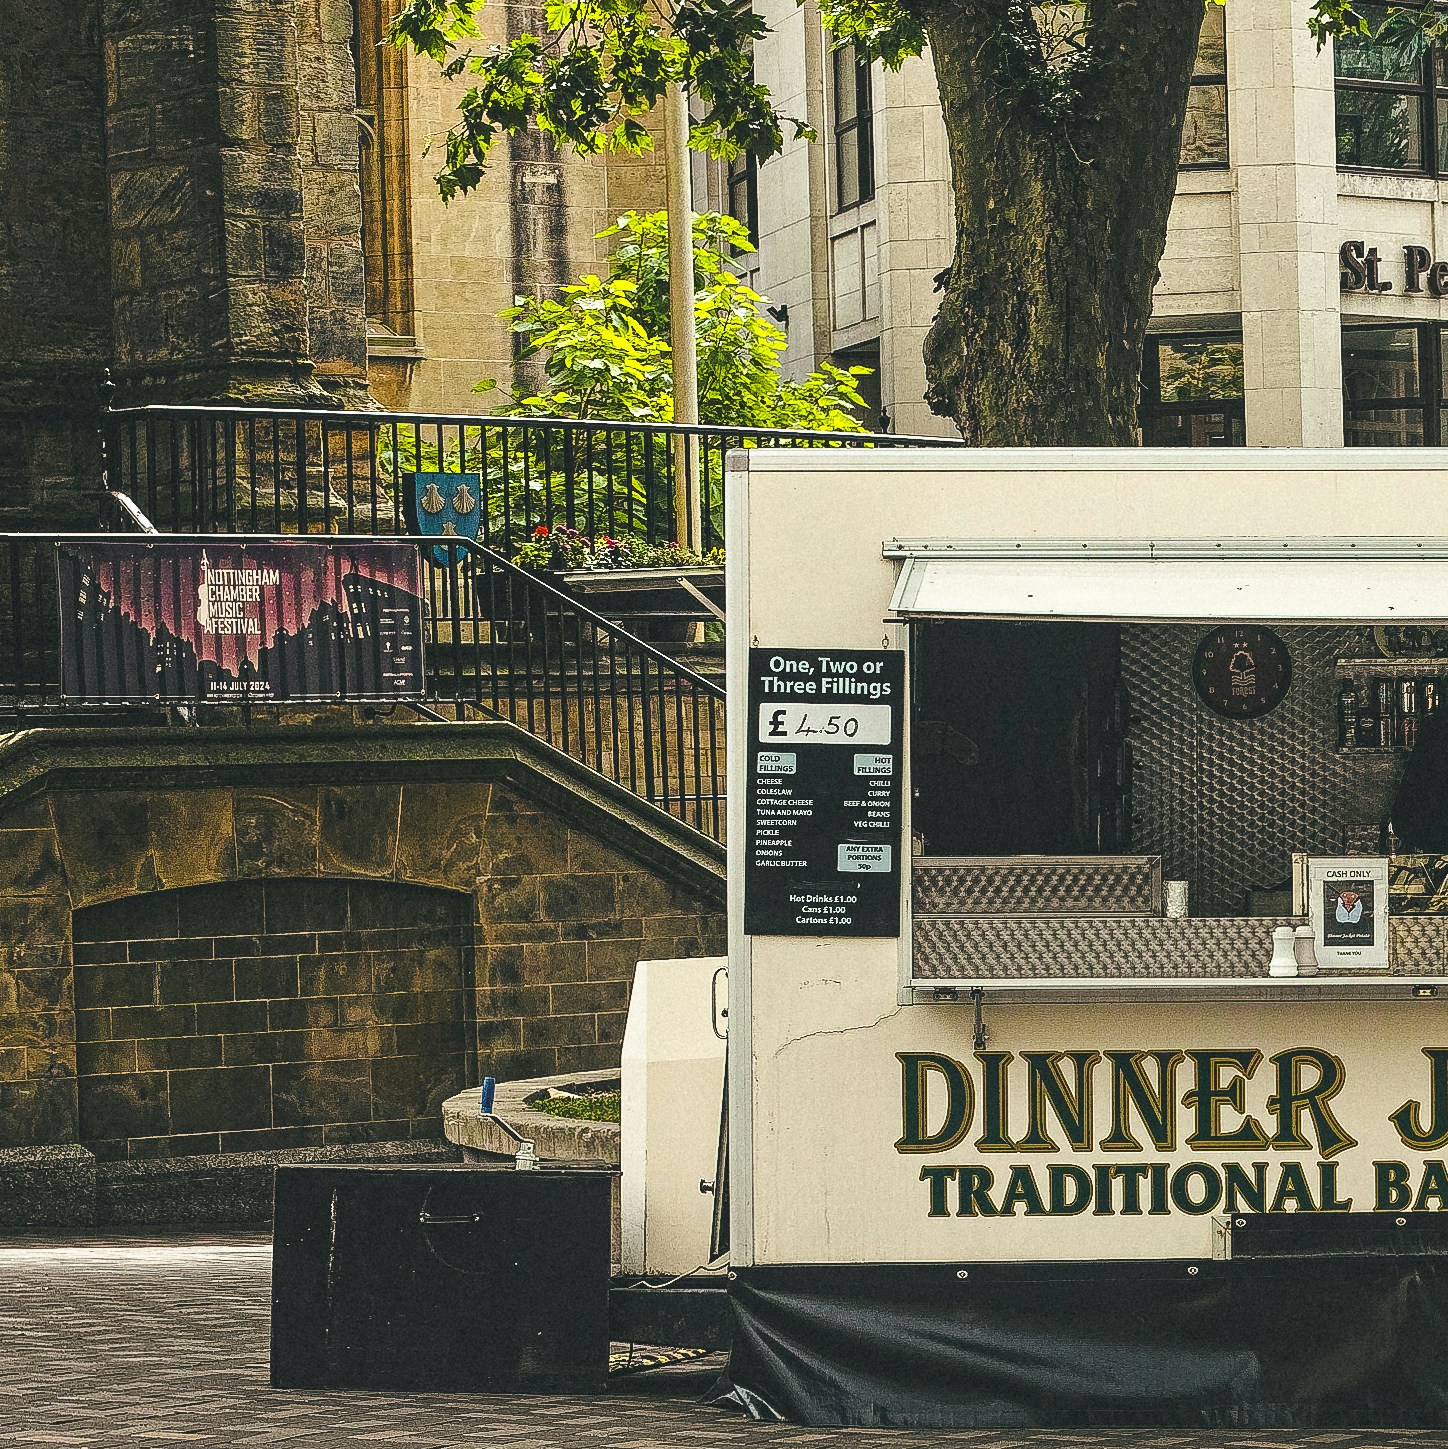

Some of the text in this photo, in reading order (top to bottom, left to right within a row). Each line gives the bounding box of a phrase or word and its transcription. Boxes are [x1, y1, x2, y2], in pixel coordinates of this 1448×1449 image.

[1338, 240, 1393, 292] St.
[207, 568, 280, 586] NOTTINGHAM
[208, 585, 261, 602] CHAMBER
[208, 601, 244, 618] MUSIC
[769, 655, 884, 676] One, Two or
[229, 681, 248, 691] JULY
[249, 681, 271, 691] 2024
[760, 676, 892, 700] Three Fillings
[759, 755, 781, 763] COLD
[759, 765, 794, 773] FILLINGS
[857, 766, 892, 774] FILLINGS
[1326, 870, 1372, 878] CASH ONLY
[789, 894, 858, 904] Hot Drinks £1.00
[801, 906, 846, 914] Cans £1.00
[795, 916, 852, 925] Cartons £1.00
[893, 1044, 1359, 1156] DINNER
[918, 1161, 1353, 1219] TRADITIONAL
